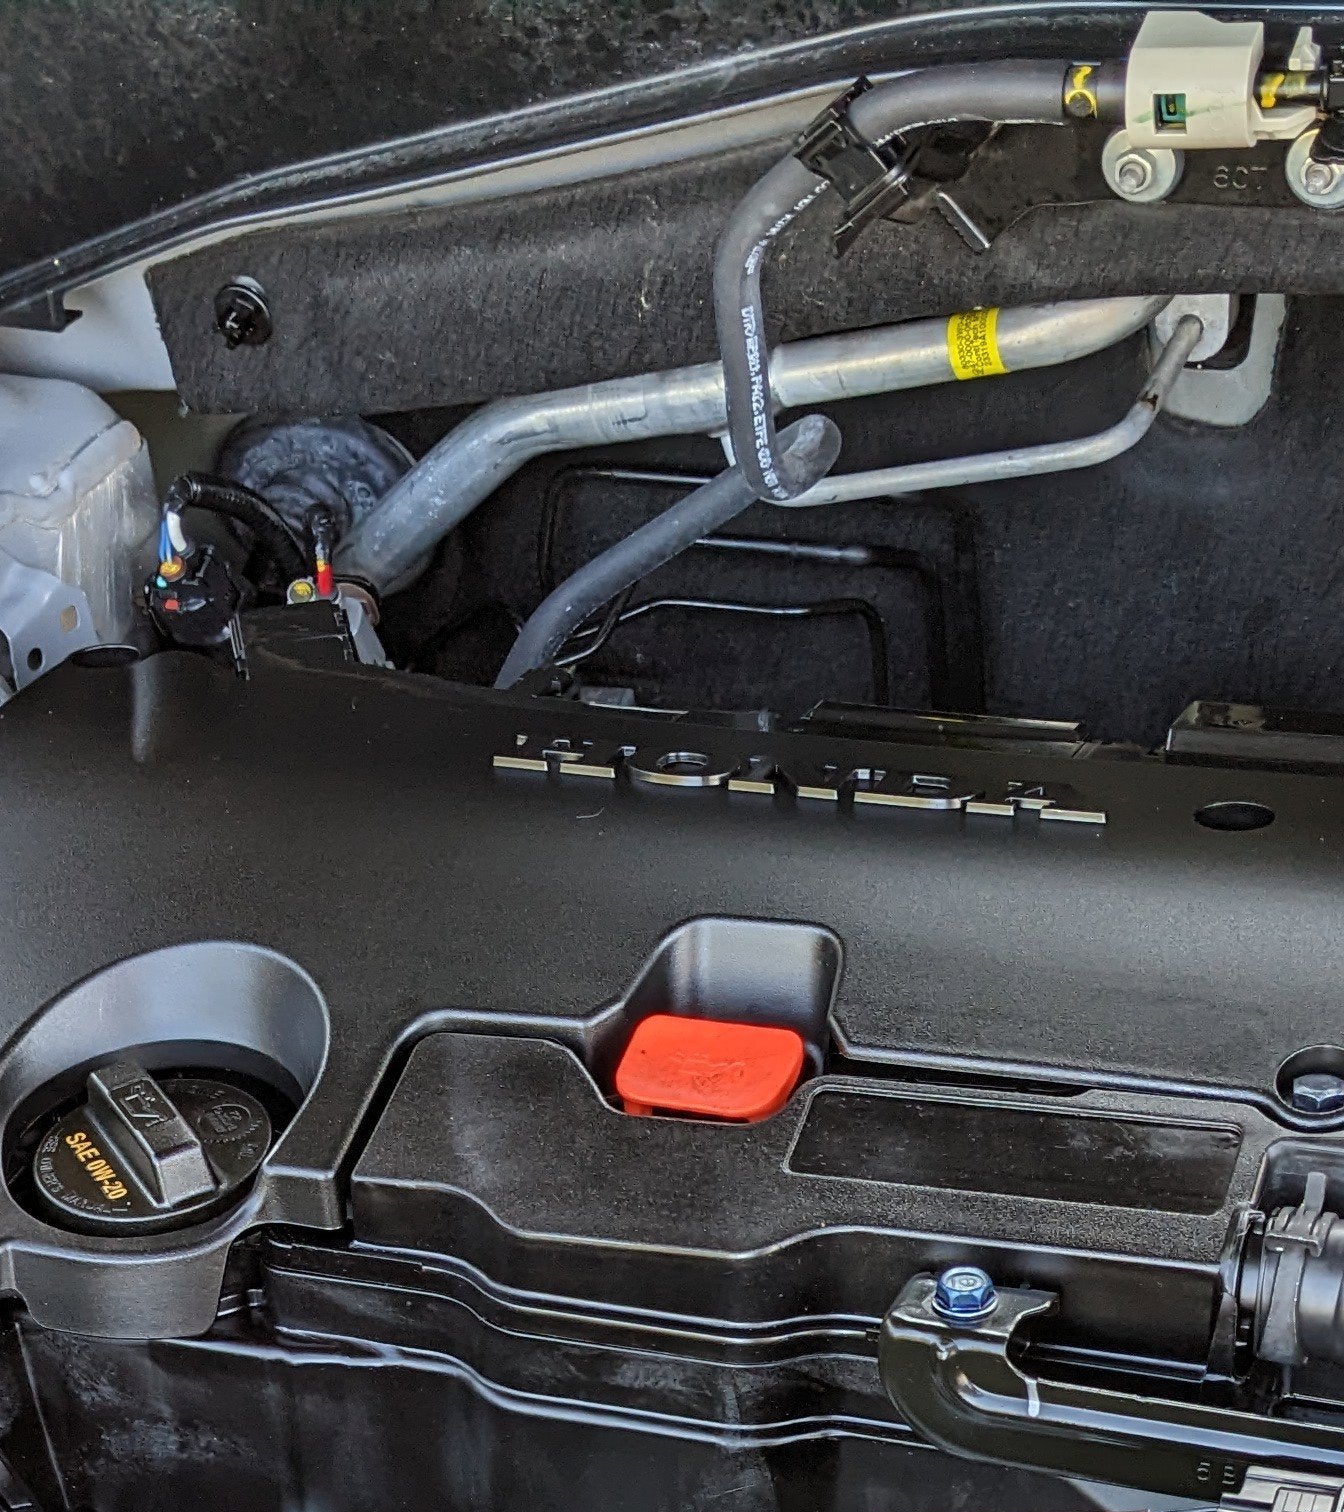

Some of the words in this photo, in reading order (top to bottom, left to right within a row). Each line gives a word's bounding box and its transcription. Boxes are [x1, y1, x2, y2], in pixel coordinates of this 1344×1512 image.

[492, 732, 1107, 825] HONDA
[65, 1131, 101, 1163] SAE
[85, 1160, 129, 1201] 0W-20
